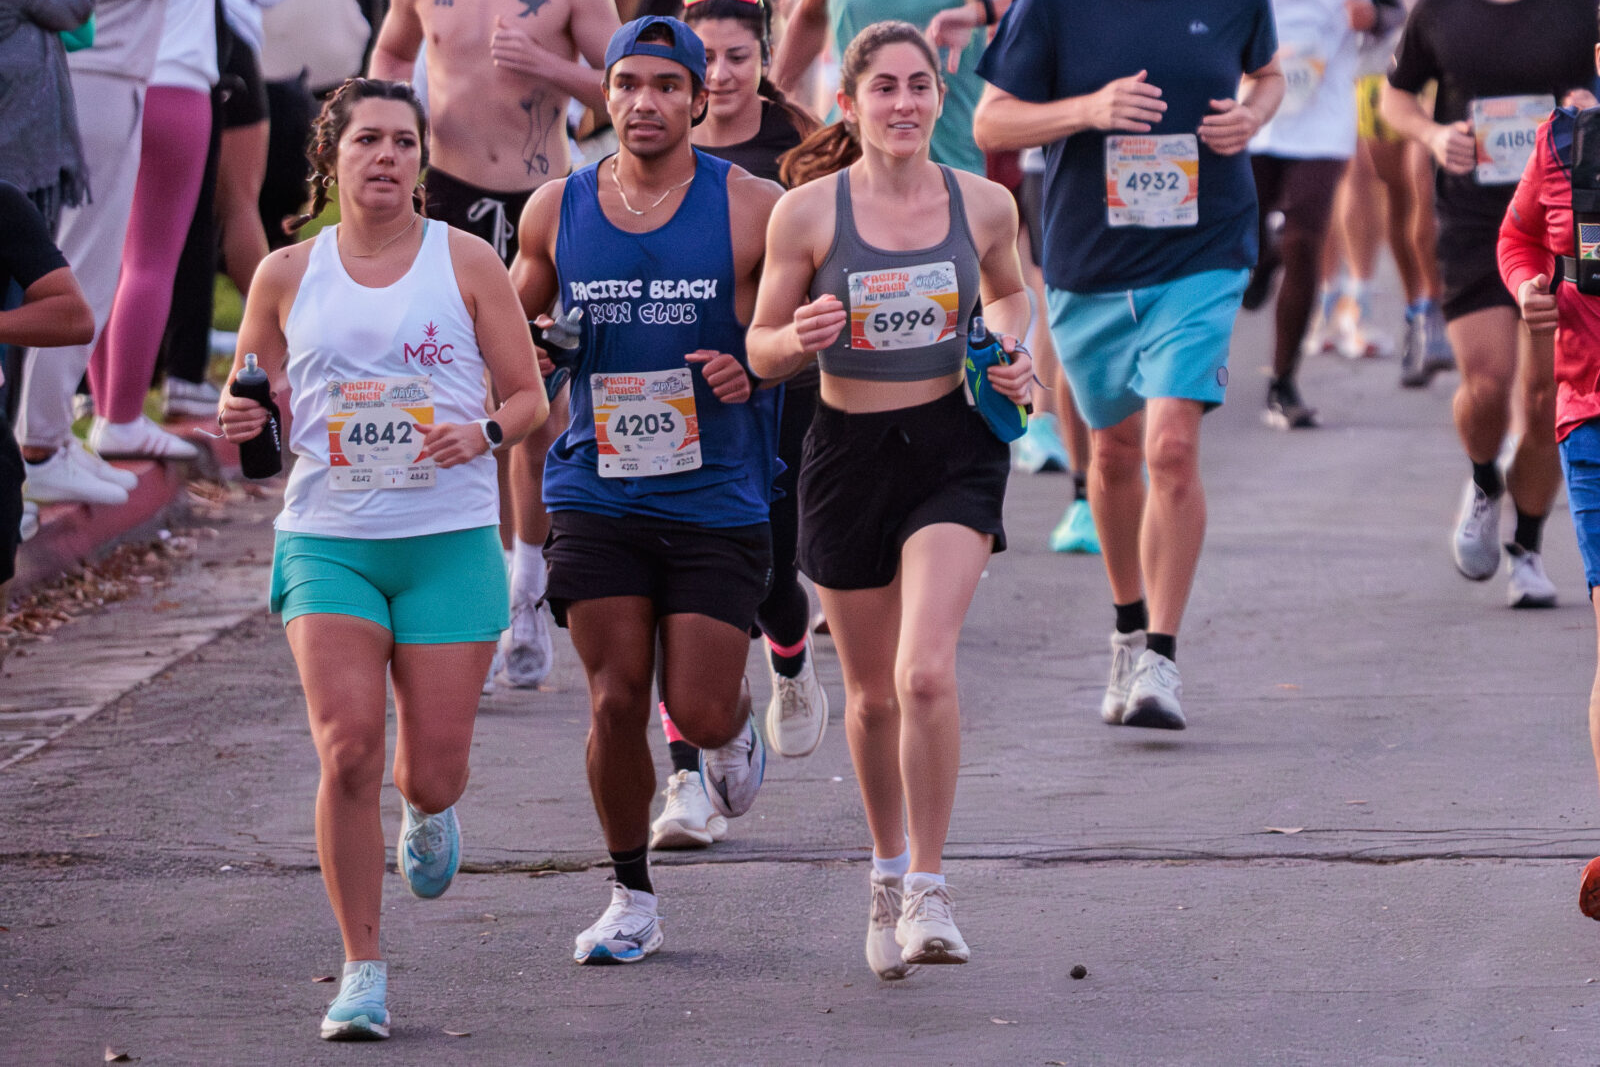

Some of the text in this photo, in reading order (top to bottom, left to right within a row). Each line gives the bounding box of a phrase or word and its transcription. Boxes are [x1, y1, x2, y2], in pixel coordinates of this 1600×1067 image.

[1126, 172, 1180, 191] 4932
[570, 279, 718, 301] PACIFIC BEACH
[588, 302, 697, 325] RUN CLUB
[873, 307, 936, 333] 5996
[403, 343, 454, 365] MRC
[340, 381, 386, 395] PACIFIC
[348, 421, 412, 445] 4842
[614, 412, 675, 436] 4203
